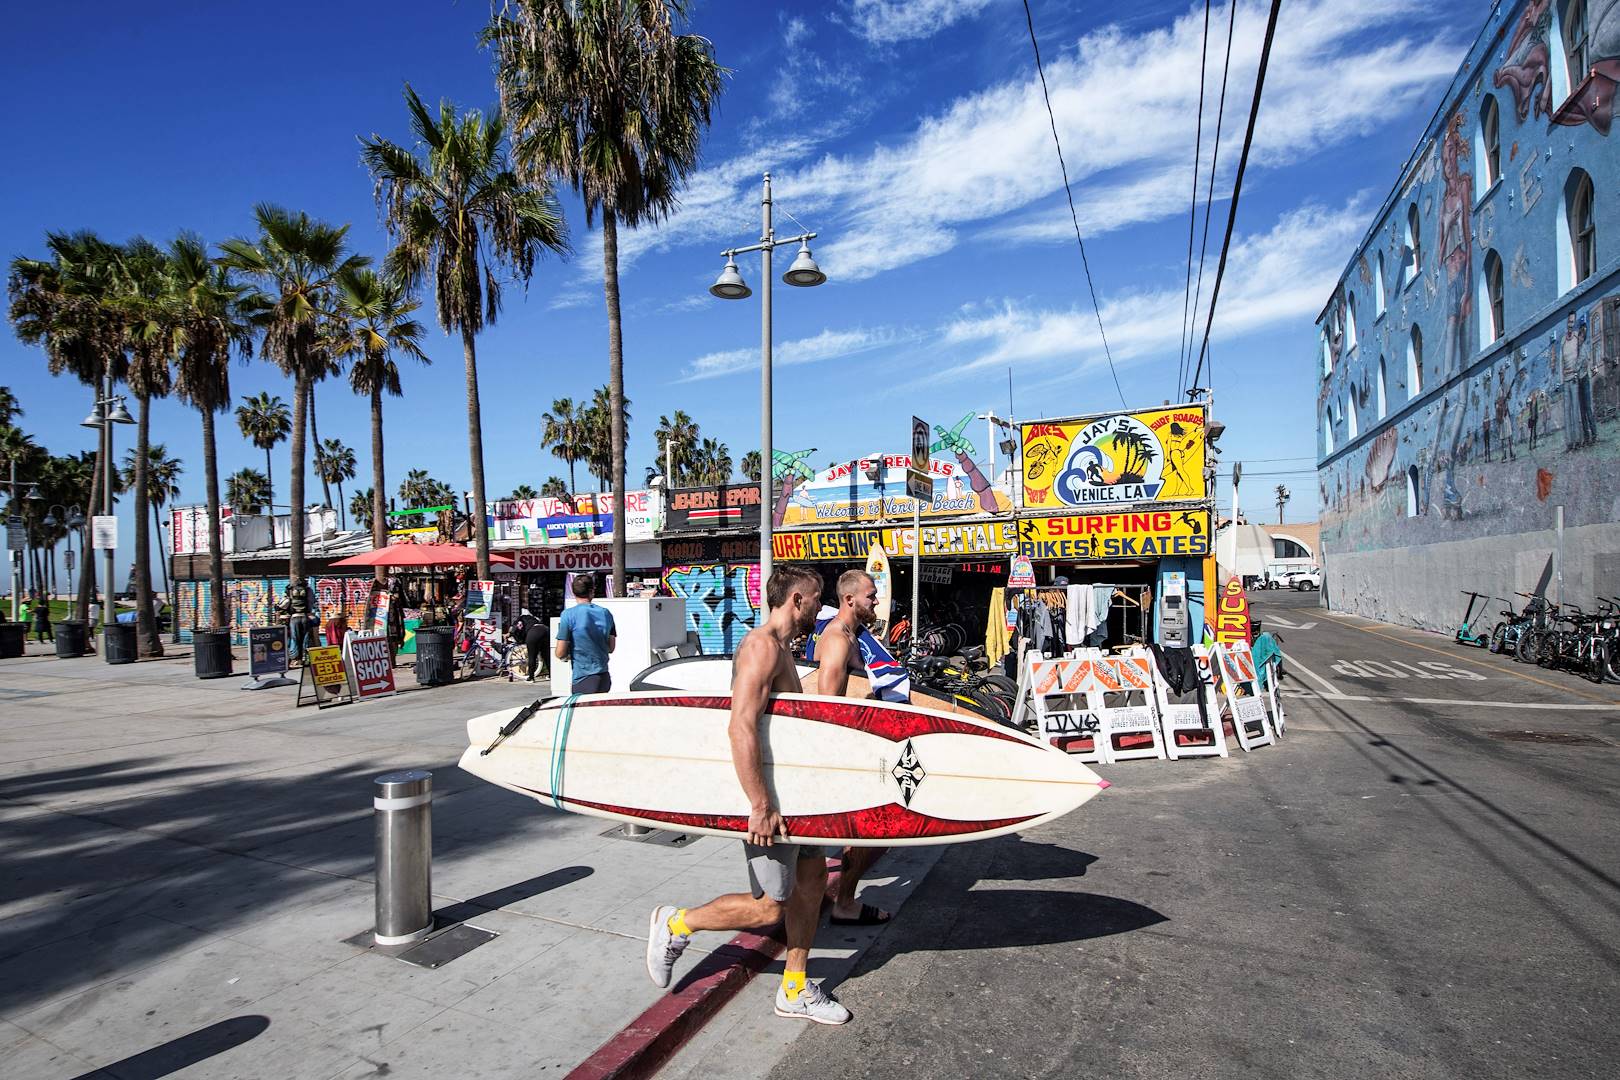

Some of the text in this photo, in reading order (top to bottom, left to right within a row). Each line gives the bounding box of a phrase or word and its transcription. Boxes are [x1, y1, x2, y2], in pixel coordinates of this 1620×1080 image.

[1082, 419, 1130, 445] JAY'S
[1150, 413, 1204, 432] SURF BOARDS
[1024, 424, 1069, 446] BIKES
[826, 459, 871, 481] JAY'S
[1073, 484, 1144, 503] VENICE, CA
[494, 500, 535, 518] LUCKY
[543, 496, 594, 518] VENICE
[814, 492, 975, 518] Welcome to Venie Beach
[626, 516, 645, 526] Lyca
[1047, 513, 1172, 536] SURFING
[582, 544, 609, 552] STORE
[772, 531, 879, 558] URF LESSONS
[885, 524, 1018, 555] J'S RENTALS
[1021, 534, 1208, 558] BIKES SKATES
[519, 552, 613, 569] SUN LOTION
[990, 565, 1001, 573] AM
[470, 581, 493, 591] EBT
[252, 632, 271, 641] Lyca
[352, 640, 389, 662] SMOKE
[316, 662, 340, 675] EBT
[319, 674, 343, 683] Cards
[357, 660, 390, 681] SHOP
[1330, 659, 1488, 681] STOP
